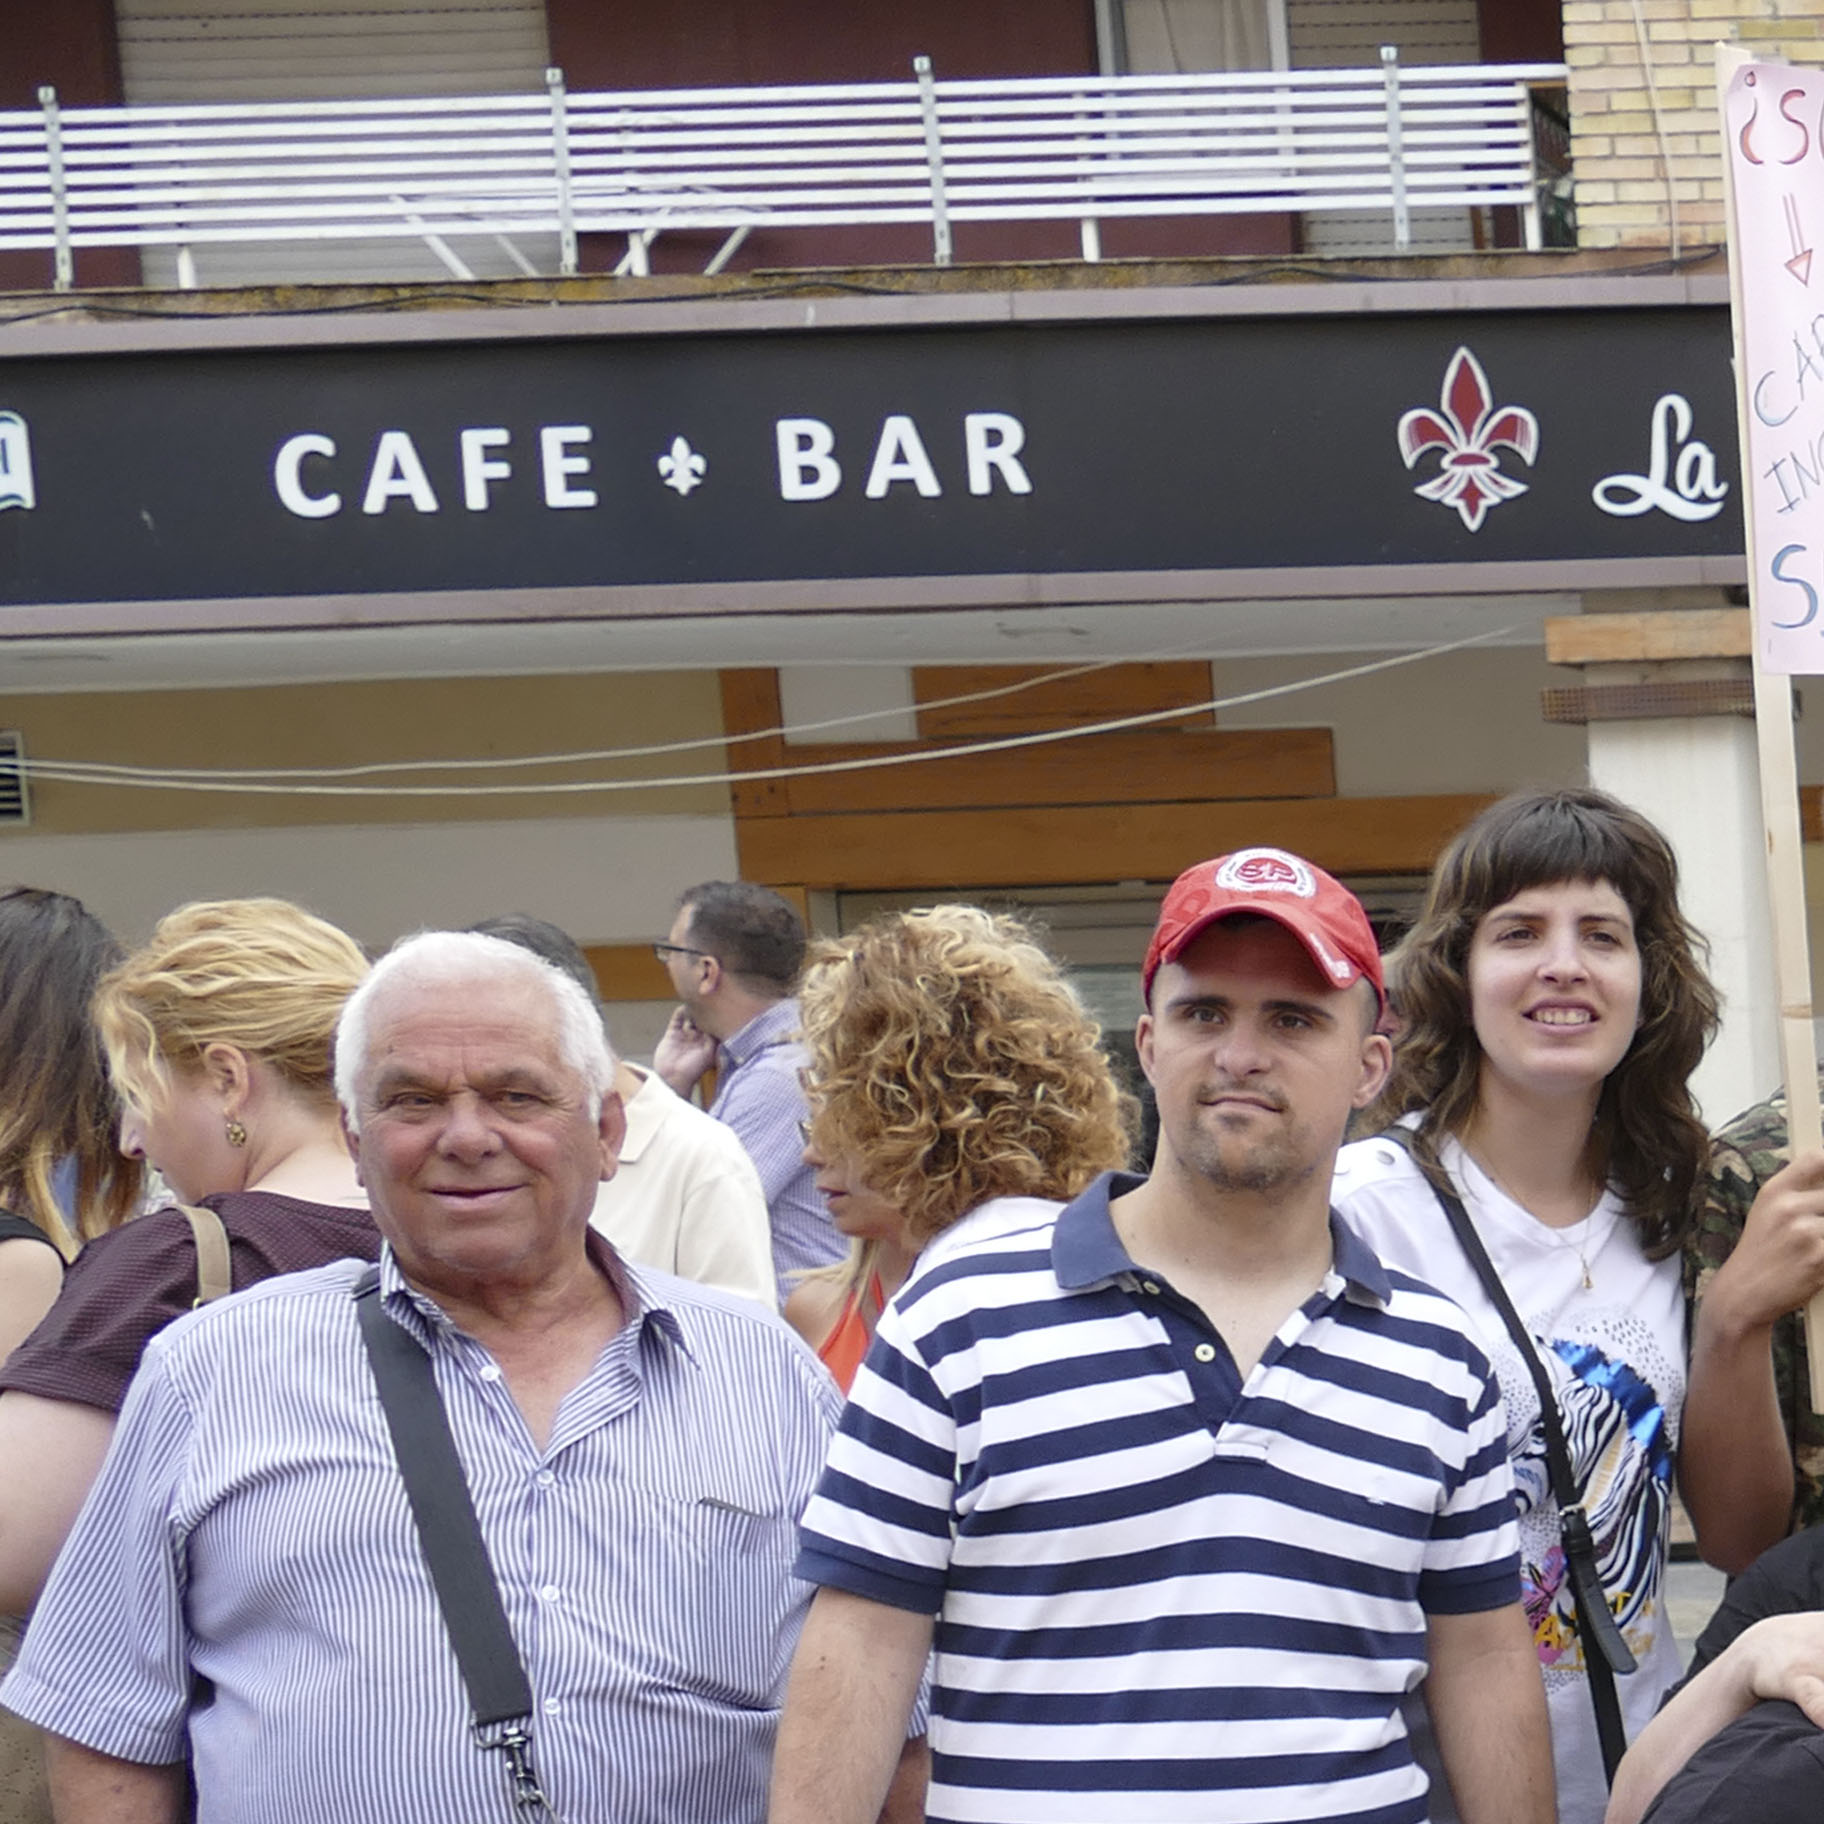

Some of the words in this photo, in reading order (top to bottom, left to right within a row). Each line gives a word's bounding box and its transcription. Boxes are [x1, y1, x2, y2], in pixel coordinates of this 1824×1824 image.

[275, 427, 597, 517] CAFE
[776, 413, 1032, 500] BAR
[1591, 394, 1729, 522] La
